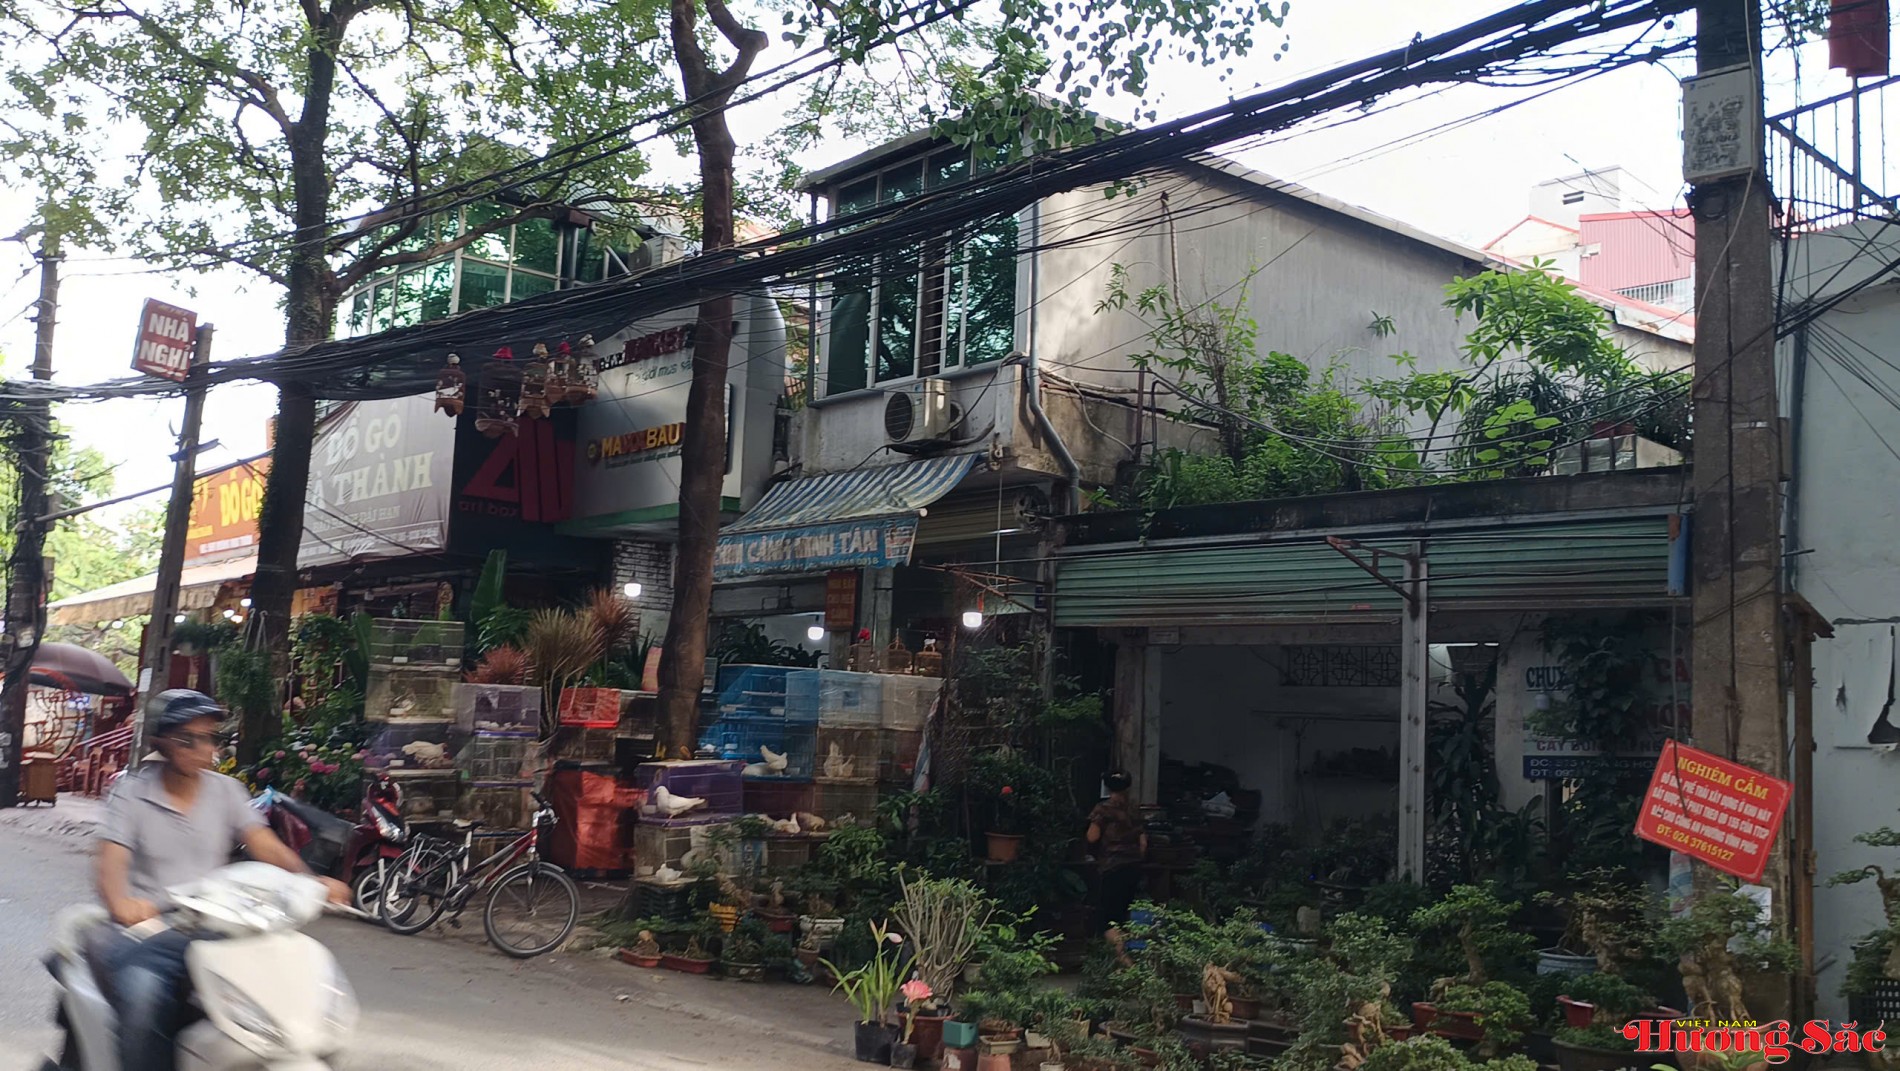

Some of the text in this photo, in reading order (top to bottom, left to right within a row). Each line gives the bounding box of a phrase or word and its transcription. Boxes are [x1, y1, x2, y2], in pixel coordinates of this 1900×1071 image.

[148, 313, 190, 343] NHÀ
[139, 340, 191, 371] NGHỈ
[333, 452, 434, 507] THÀNH
[839, 527, 878, 555] TÂN
[1734, 777, 1769, 800] CẤM
